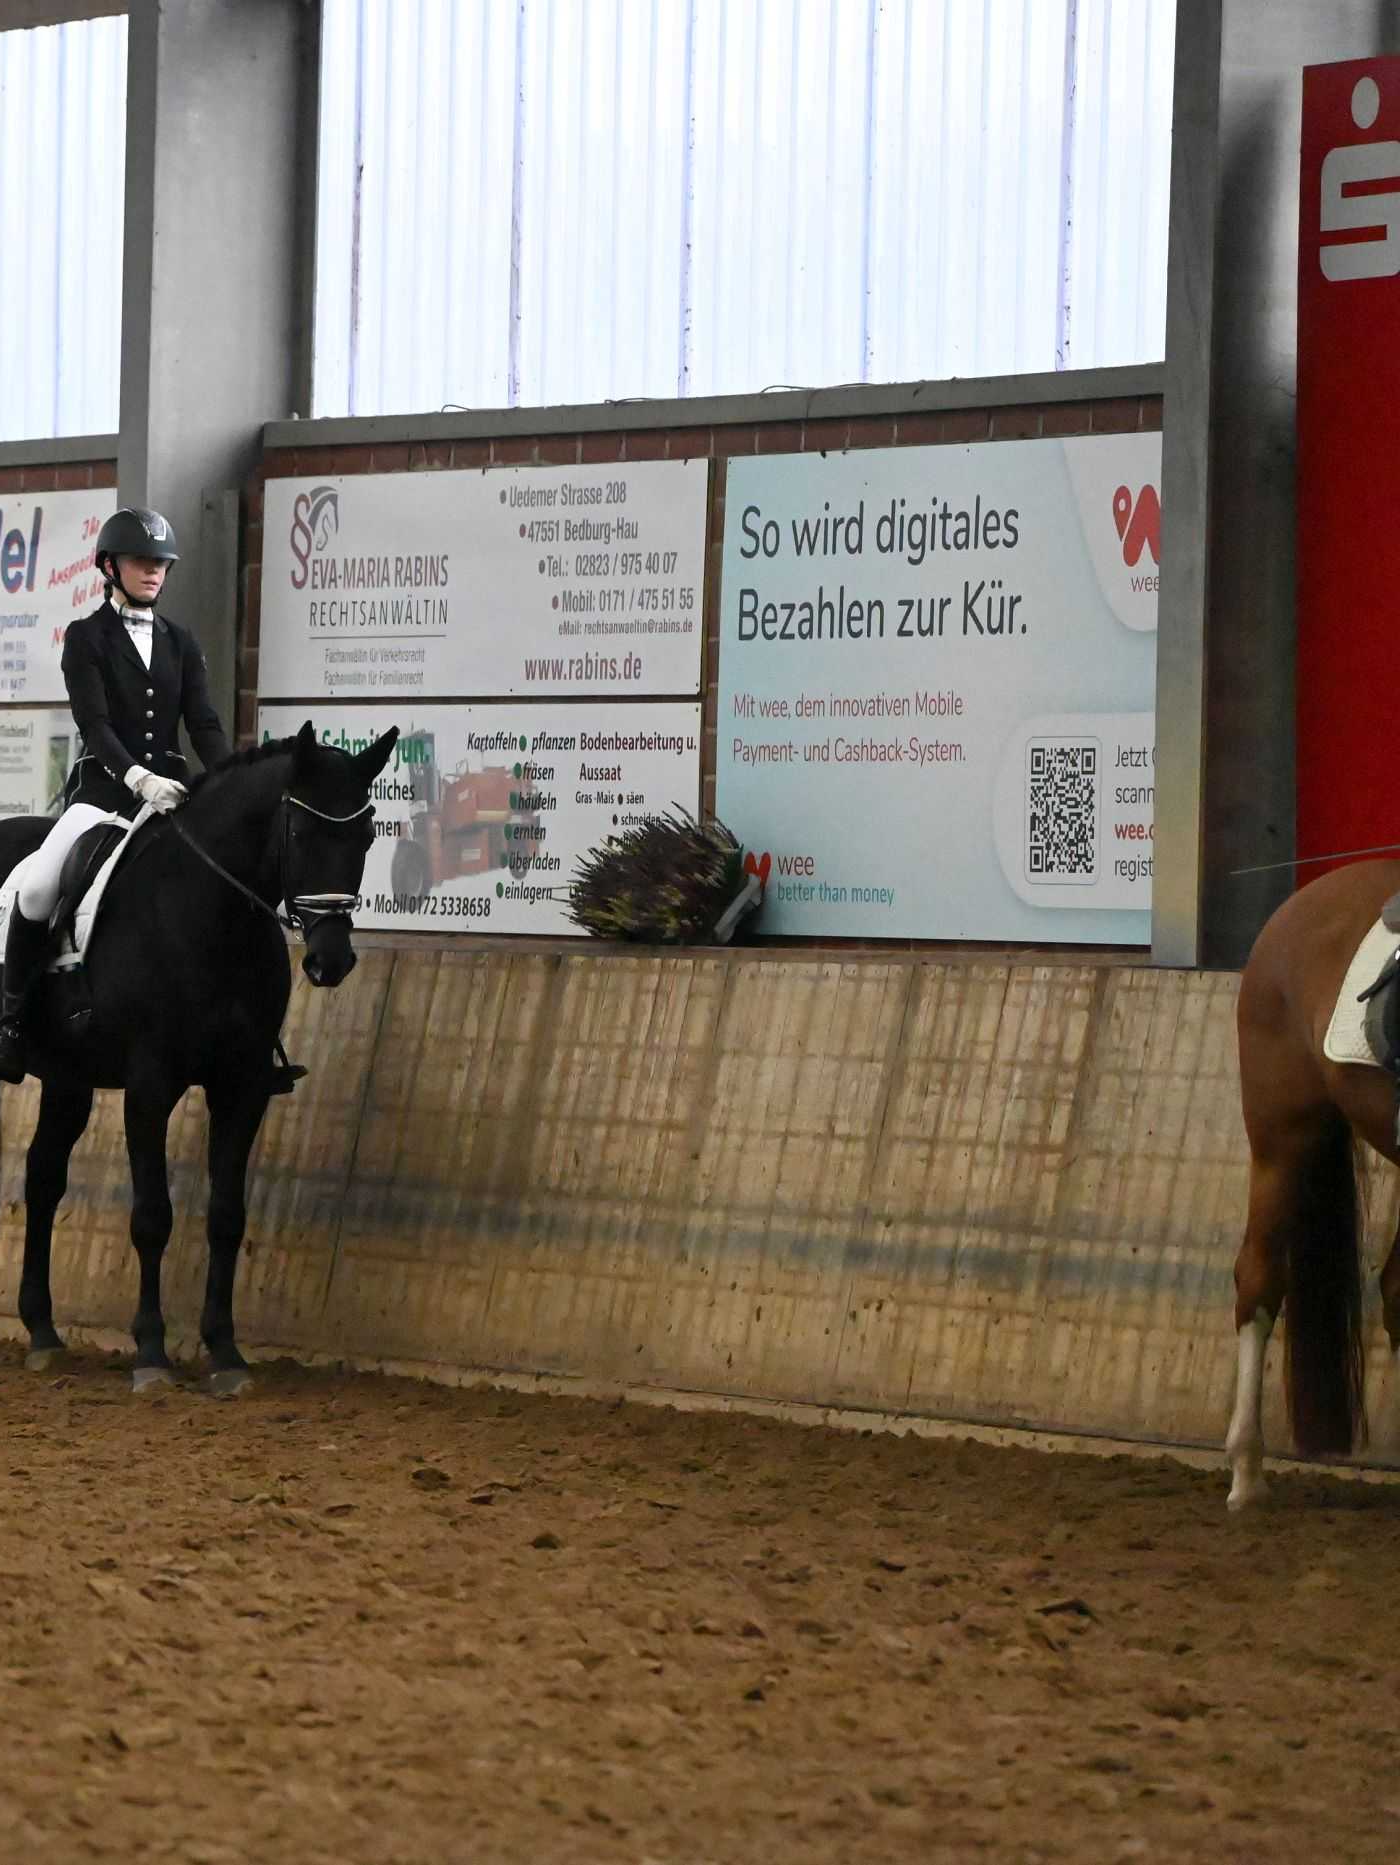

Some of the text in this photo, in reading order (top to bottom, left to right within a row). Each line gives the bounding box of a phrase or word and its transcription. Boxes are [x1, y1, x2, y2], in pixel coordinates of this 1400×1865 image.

[510, 481, 627, 508] Uedemer Strasse 208
[527, 517, 639, 544] 47551 Bedburg-Hau
[740, 494, 1019, 566] So wird digitales
[395, 554, 449, 588] RABINS
[546, 551, 678, 577] Tel.: 02823 / 975 40 07
[1131, 576, 1160, 593] wee
[309, 594, 448, 627] RECHTSANWÄLTIN
[562, 587, 694, 613] Mobil: 0171 / 475 51 55
[738, 580, 1027, 641] Bezahlen zur Kür.
[558, 616, 693, 635] eMail: rechtsanwaeltin@rabins.de
[524, 652, 642, 681] www.rabins.de
[733, 690, 963, 720] Mit wee, dem innovativen Mobile
[394, 736, 430, 773] jun.
[467, 732, 697, 755] Kartoffeln pflanzen Bodenbearbeitung u.
[732, 736, 967, 768] Payment- und Cashback-System.
[1115, 744, 1148, 767] Jetzt
[522, 762, 555, 781] fräsen
[579, 763, 622, 781] Aussaat
[518, 792, 557, 811] häufeln
[626, 793, 645, 805] säen
[513, 824, 546, 841] ernten
[509, 852, 561, 871] überladen
[777, 855, 815, 876] wee
[374, 893, 408, 914] Mobil
[409, 895, 438, 916] 0172
[440, 896, 491, 918] 5338658
[505, 882, 552, 905] einlagern
[777, 880, 895, 907] better than money
